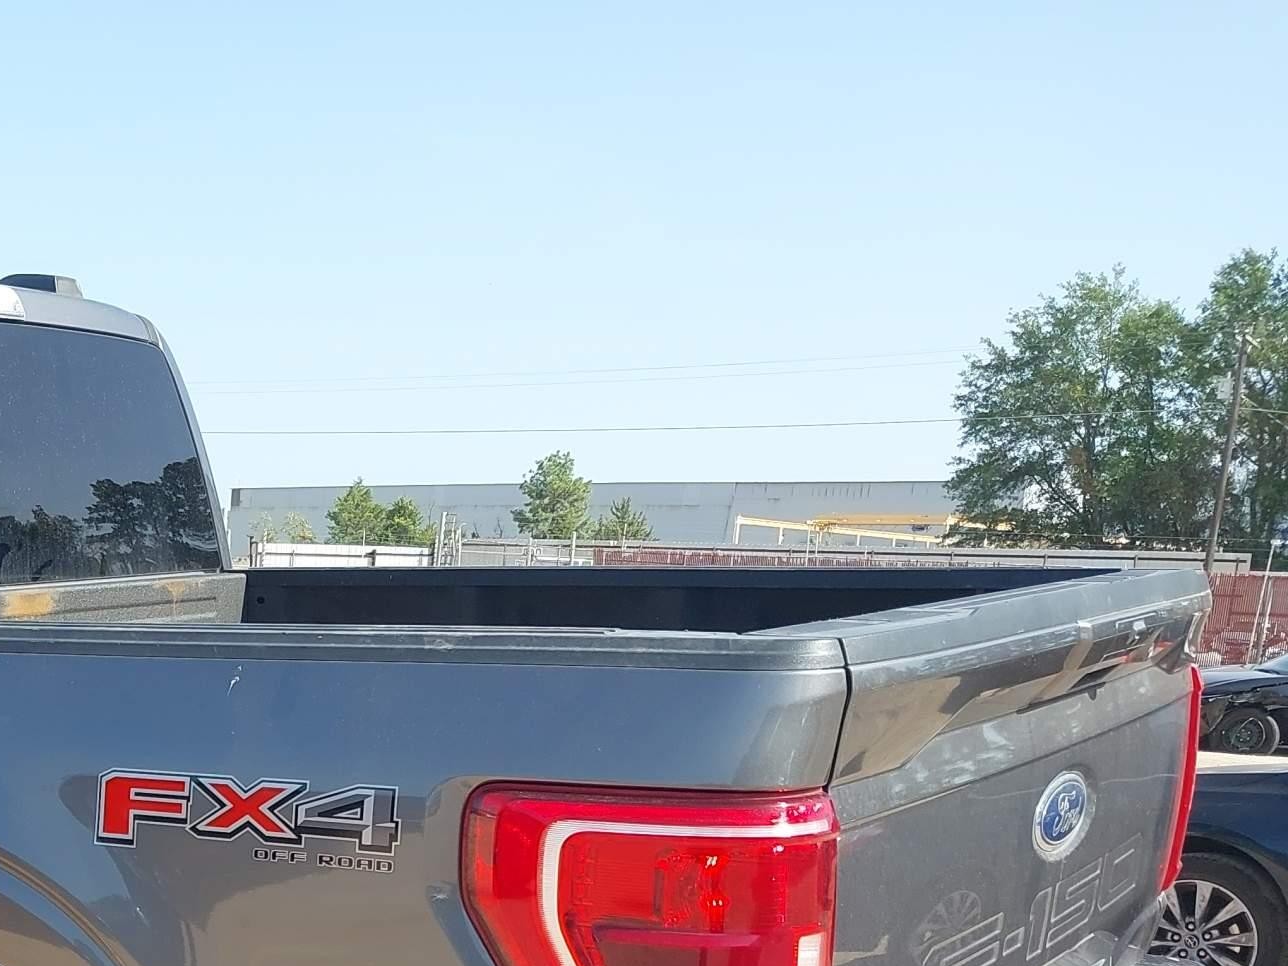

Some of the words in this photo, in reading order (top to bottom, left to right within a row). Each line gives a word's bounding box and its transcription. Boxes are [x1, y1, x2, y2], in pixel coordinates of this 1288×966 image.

[94, 768, 400, 857] FX4
[253, 848, 308, 865] OFF
[316, 853, 395, 874] ROAD
